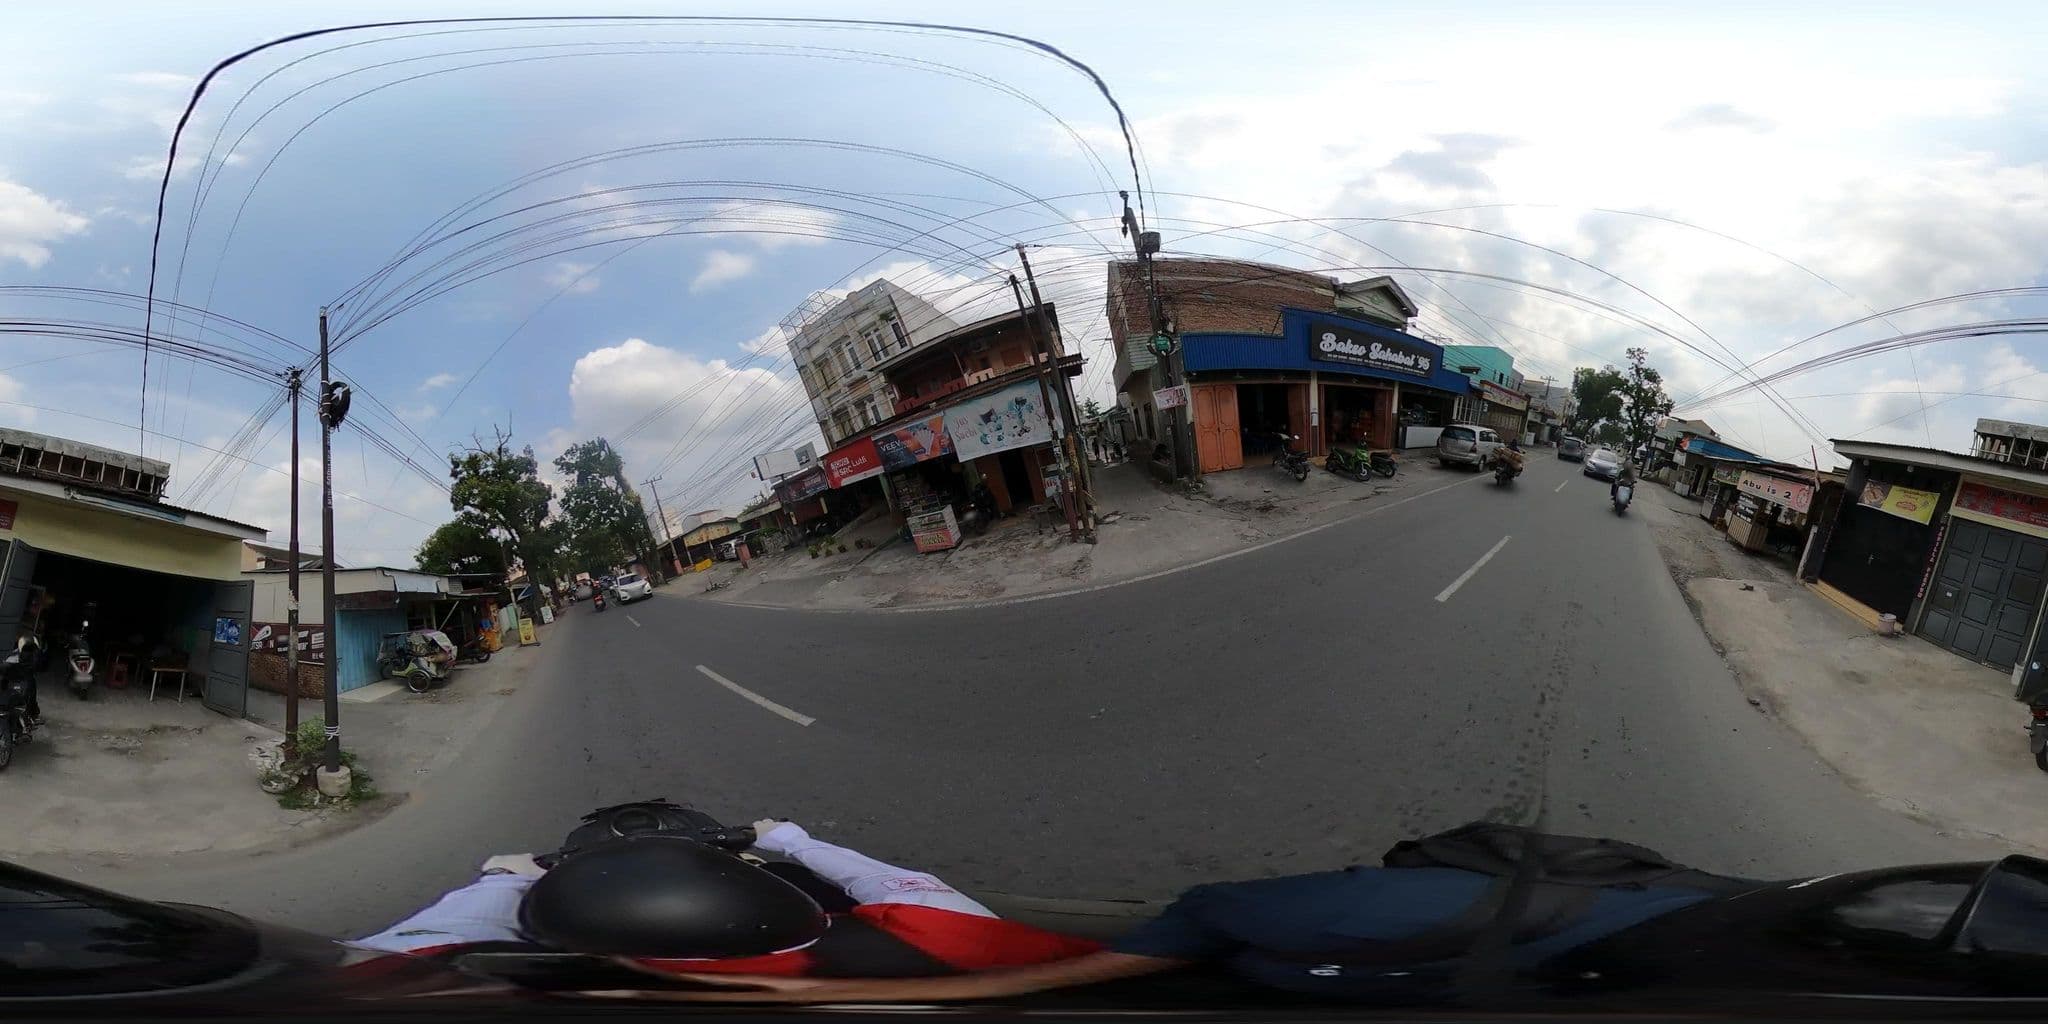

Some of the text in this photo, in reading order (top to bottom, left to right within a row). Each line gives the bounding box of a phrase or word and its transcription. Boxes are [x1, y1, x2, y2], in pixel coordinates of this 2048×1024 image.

[1319, 332, 1367, 356] Bakso
[1742, 479, 1762, 490] Abu
[1783, 491, 1792, 500] 2
